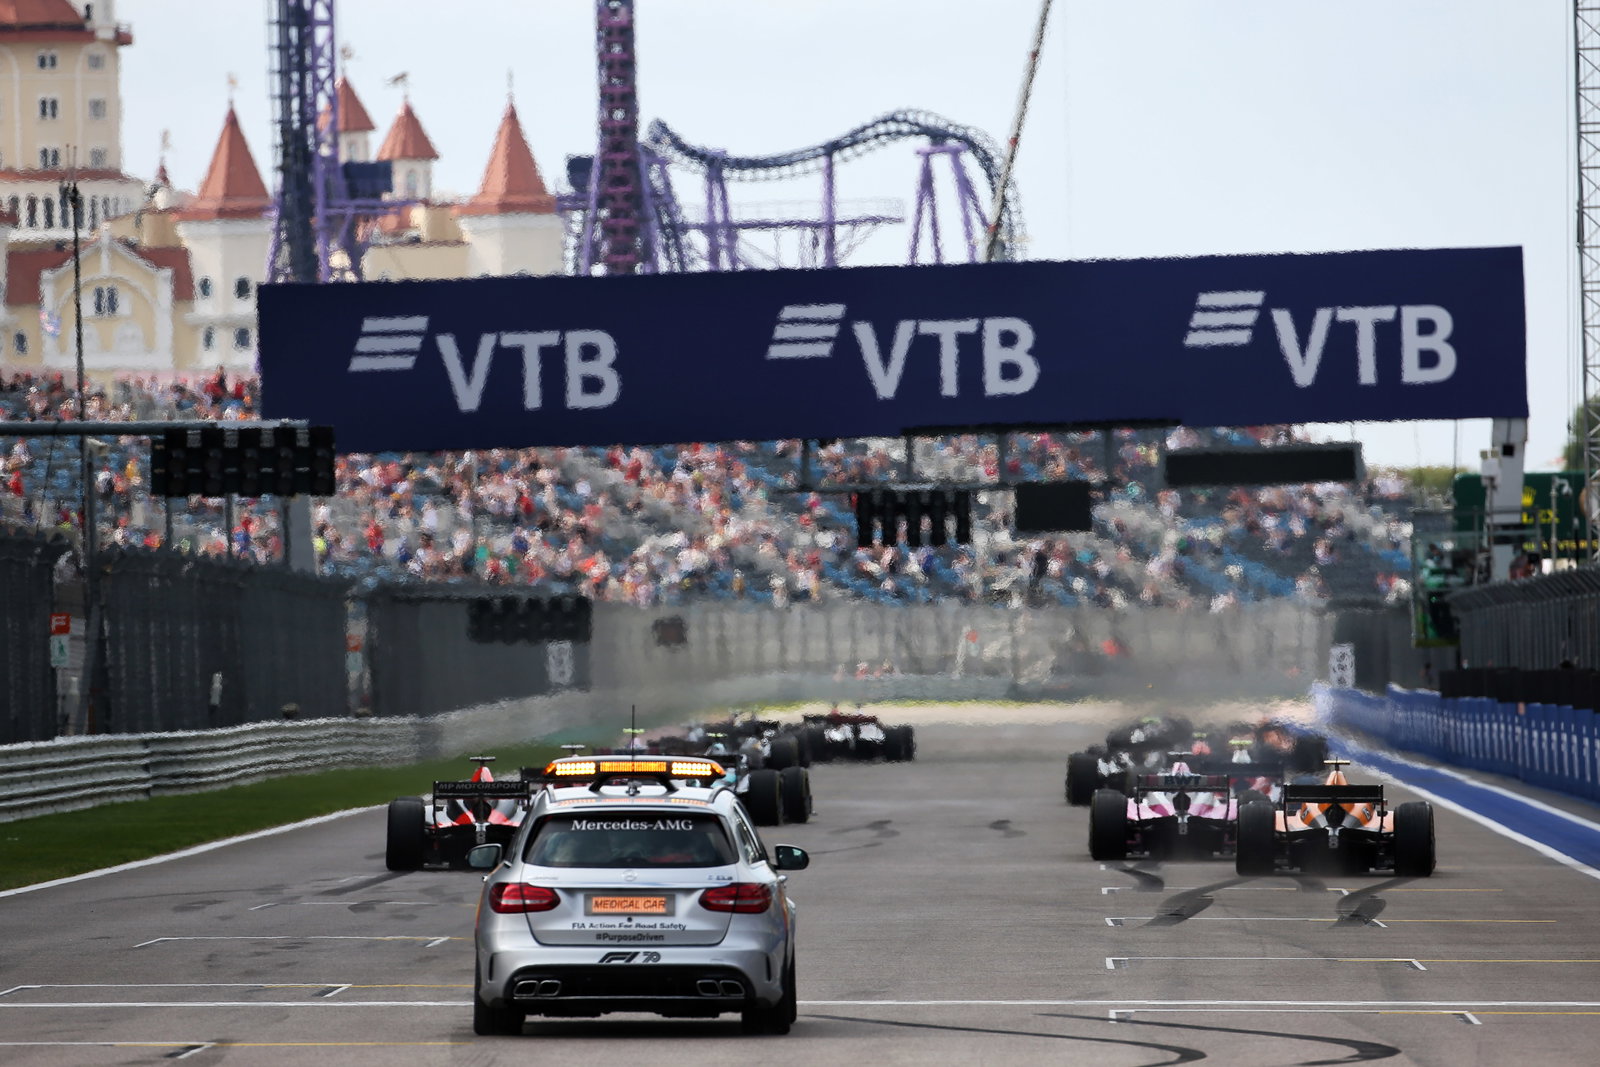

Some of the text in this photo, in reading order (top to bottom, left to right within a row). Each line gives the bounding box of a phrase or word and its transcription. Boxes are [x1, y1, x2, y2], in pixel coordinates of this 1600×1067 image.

[1271, 304, 1458, 388] VTB
[852, 316, 1040, 400] VTB
[435, 328, 622, 413] VTB
[1521, 509, 1560, 525] LEX
[571, 819, 692, 831] Mercedes-AMG
[593, 899, 666, 910] MEDICAL CAR
[572, 922, 586, 930] FIA
[659, 922, 687, 932] Safety
[596, 932, 665, 943] #PurposeDriven
